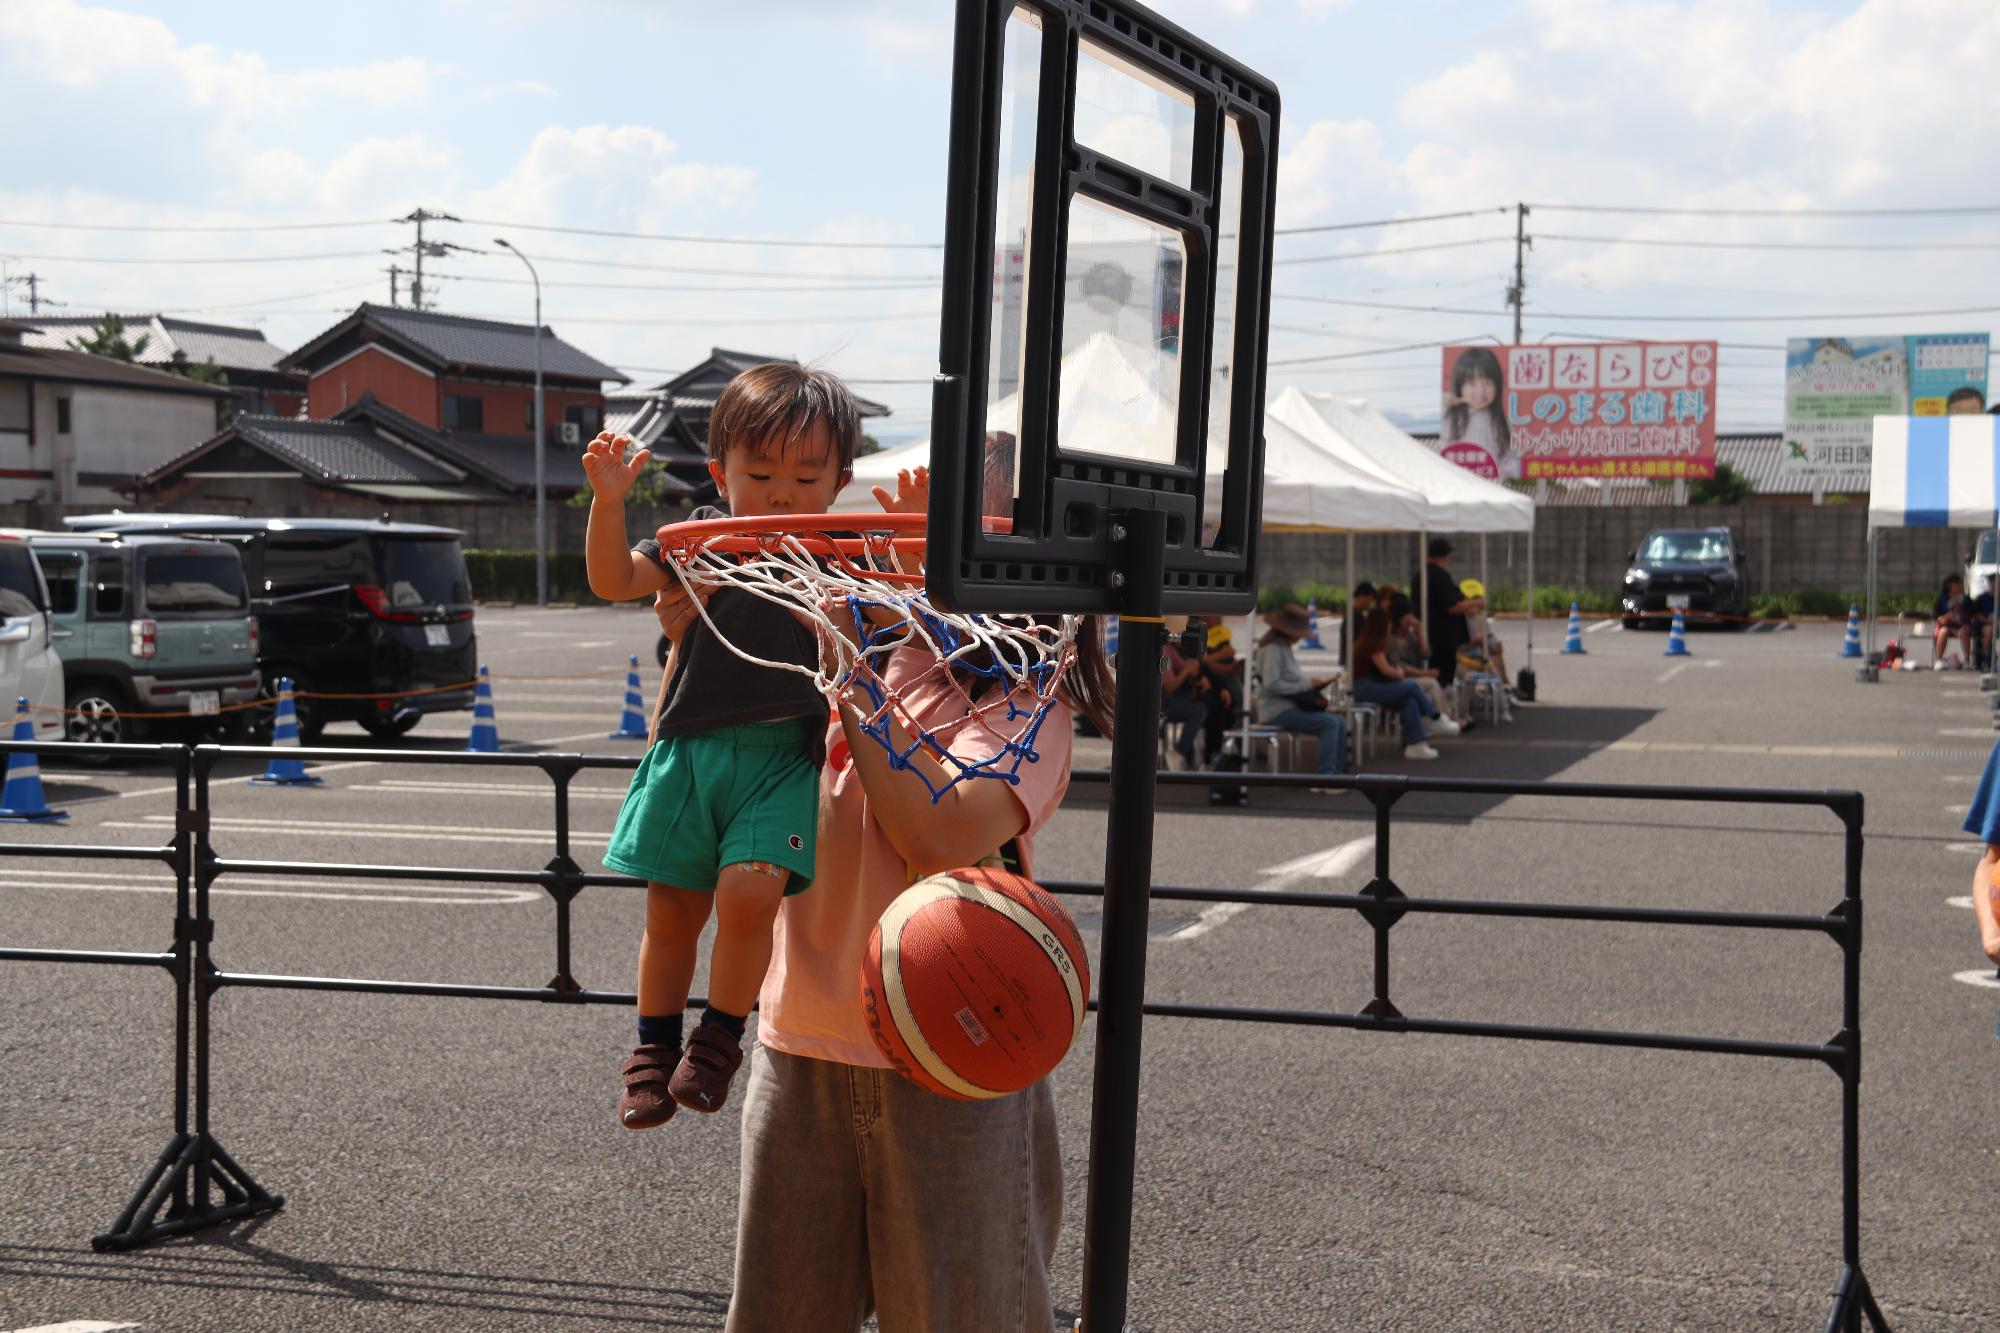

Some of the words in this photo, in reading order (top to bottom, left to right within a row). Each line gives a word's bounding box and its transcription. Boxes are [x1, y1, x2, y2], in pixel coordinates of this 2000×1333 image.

[1514, 350, 1684, 384] 歯ならび
[1509, 389, 1710, 425] しのまる歯科
